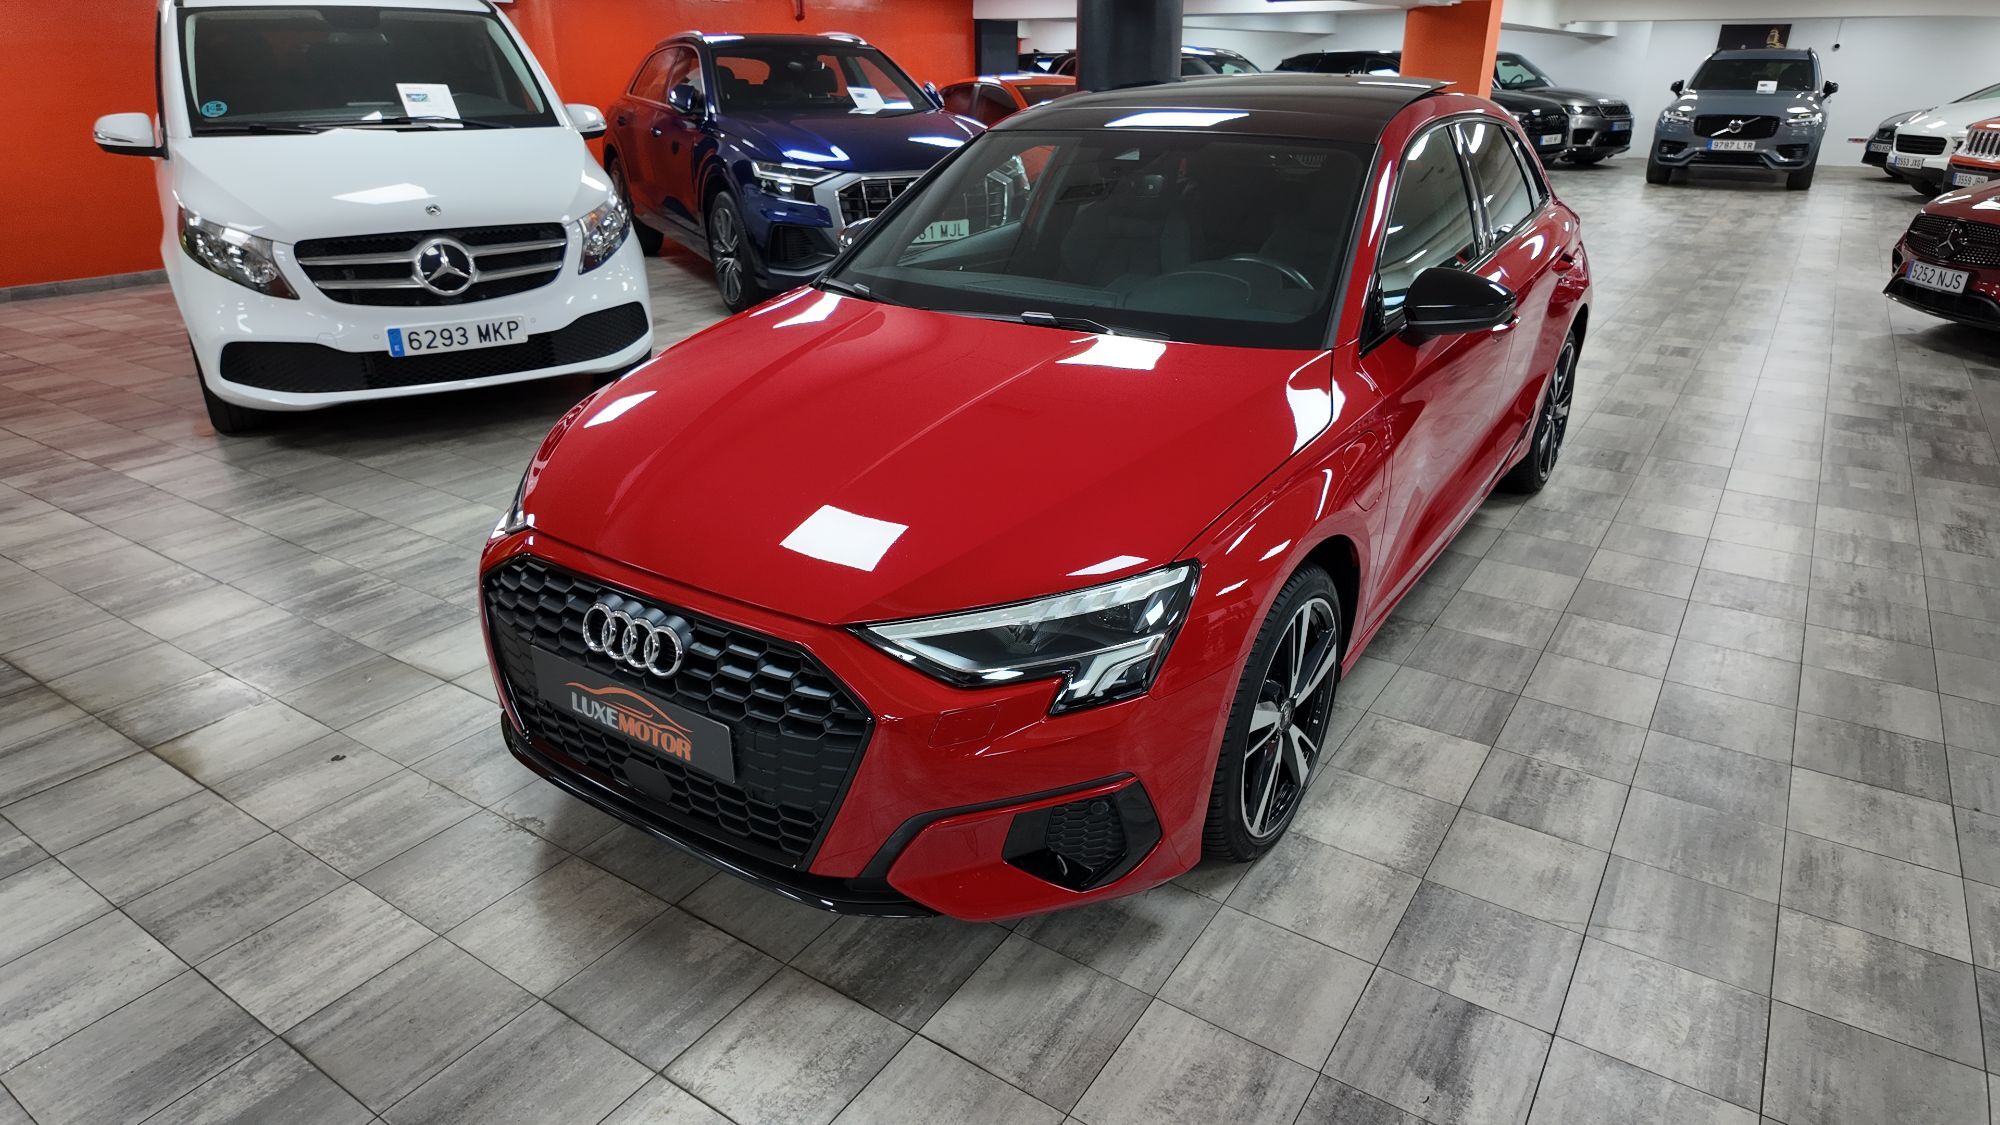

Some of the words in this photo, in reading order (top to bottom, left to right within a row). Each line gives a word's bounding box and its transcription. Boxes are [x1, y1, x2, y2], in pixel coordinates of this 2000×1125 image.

[940, 223, 965, 238] MJL
[1912, 263, 1936, 284] 5252
[1936, 270, 1962, 290] NJS
[408, 326, 469, 351] 6293
[477, 320, 519, 344] MKP
[571, 691, 692, 761] LUXEMOTOR
